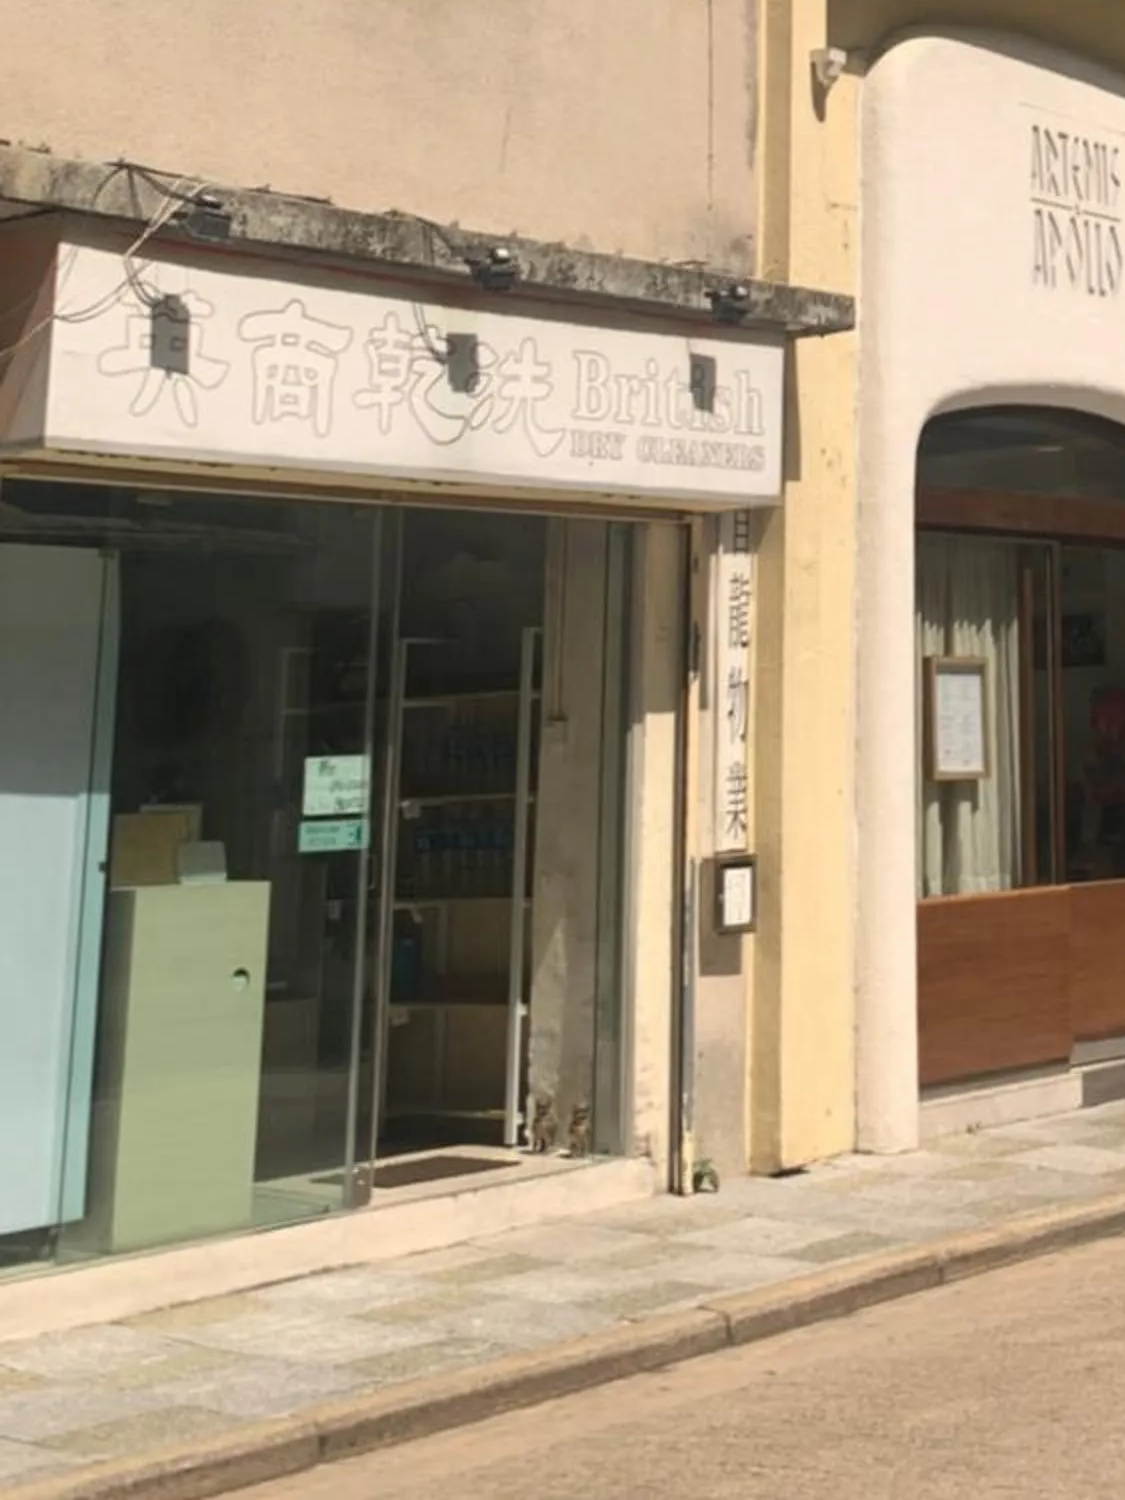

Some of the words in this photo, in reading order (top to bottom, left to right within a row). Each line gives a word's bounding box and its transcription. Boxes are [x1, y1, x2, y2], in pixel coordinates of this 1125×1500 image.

[97, 281, 566, 457] 英商乾洗
[571, 349, 765, 436] British
[569, 428, 627, 460] DRY
[636, 435, 766, 471] CLEANERS
